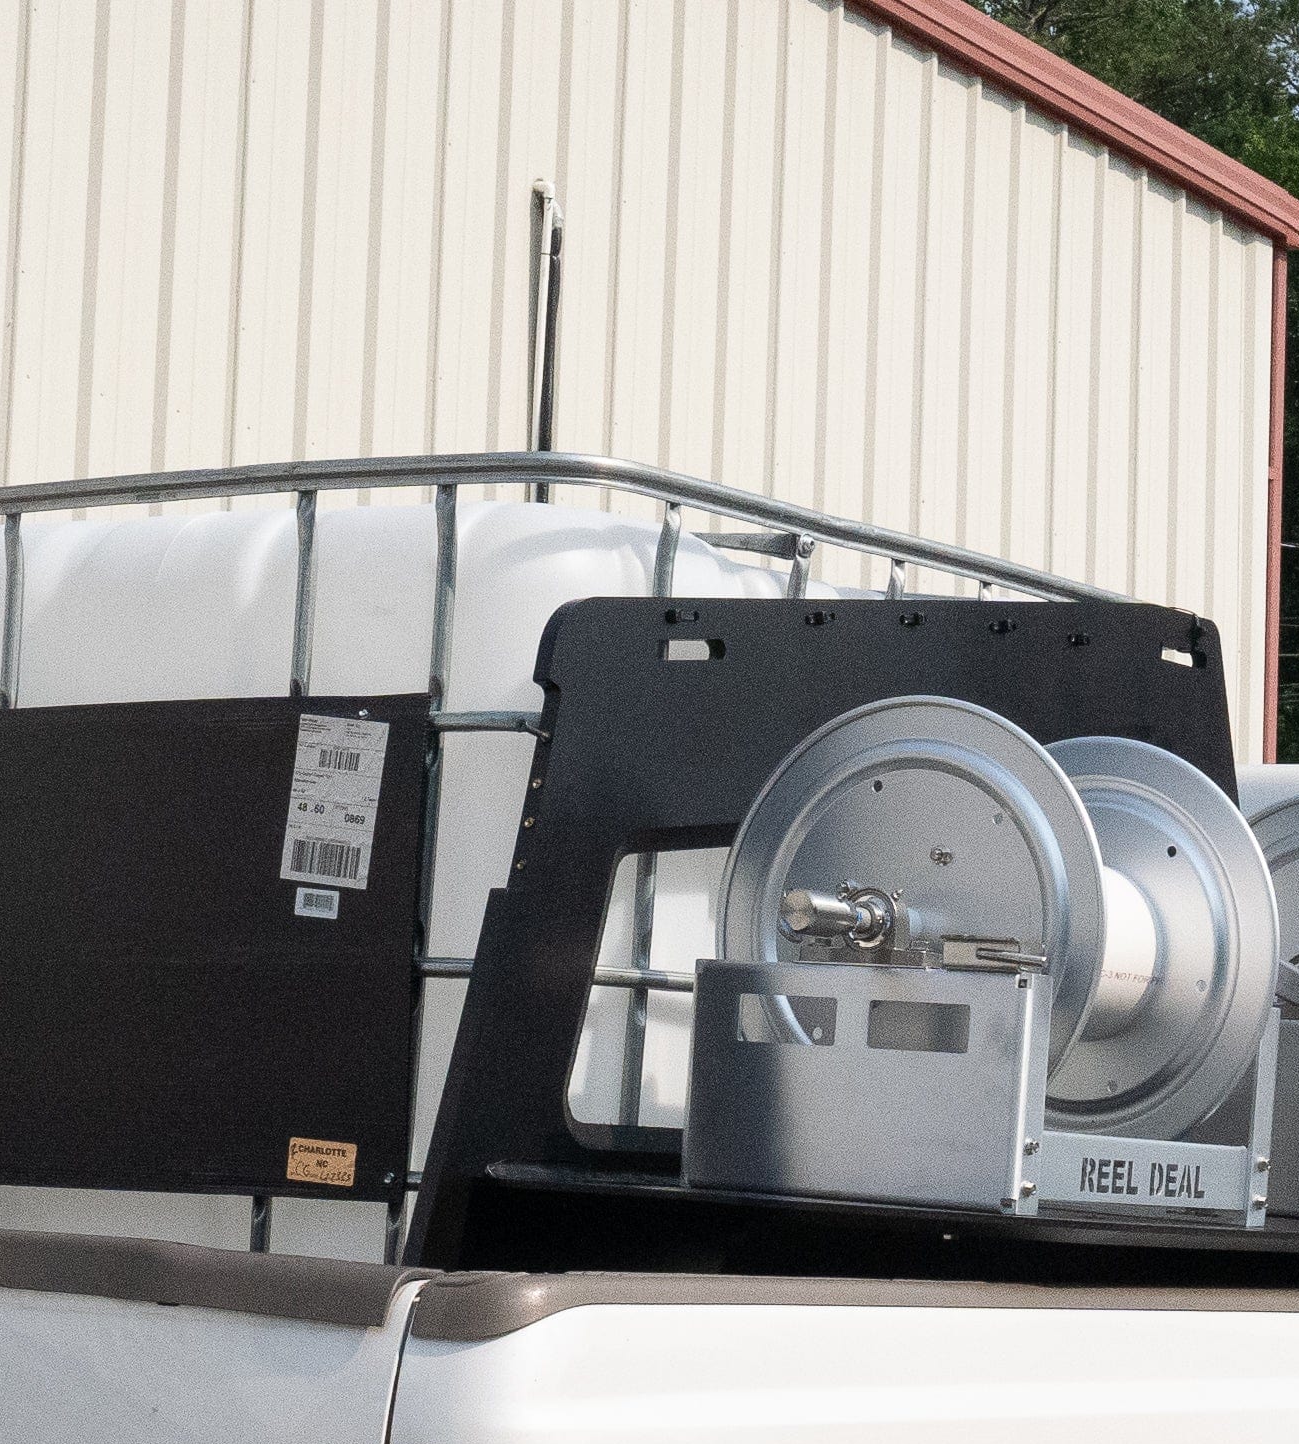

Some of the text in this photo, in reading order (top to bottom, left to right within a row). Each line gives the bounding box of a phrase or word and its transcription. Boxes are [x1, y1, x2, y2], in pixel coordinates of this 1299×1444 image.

[298, 1144, 347, 1158] CHARLOTTE
[316, 1159, 329, 1168] NC
[1079, 1157, 1205, 1199] REEL DEAL
